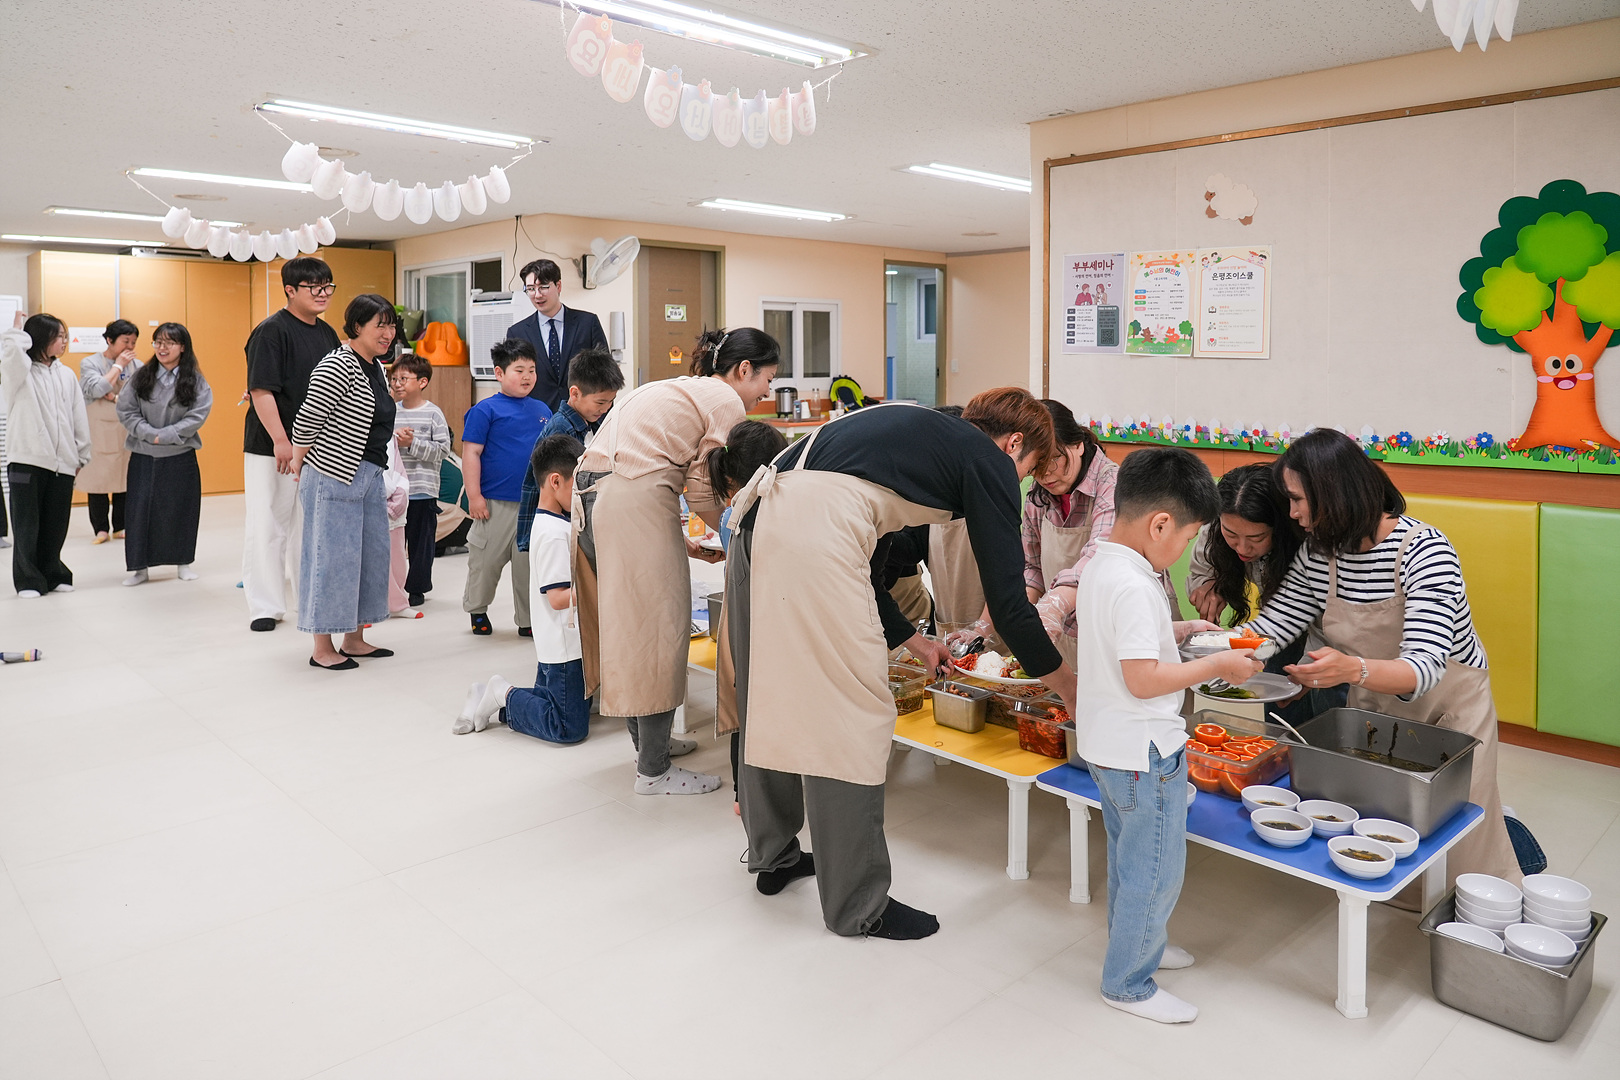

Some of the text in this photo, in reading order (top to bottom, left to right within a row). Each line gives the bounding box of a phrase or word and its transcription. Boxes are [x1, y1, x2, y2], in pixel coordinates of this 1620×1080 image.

[1072, 259, 1114, 272] 부부세미나
[1144, 267, 1181, 278] 예수님의 어린이
[1211, 271, 1253, 281] 은평조이스쿨
